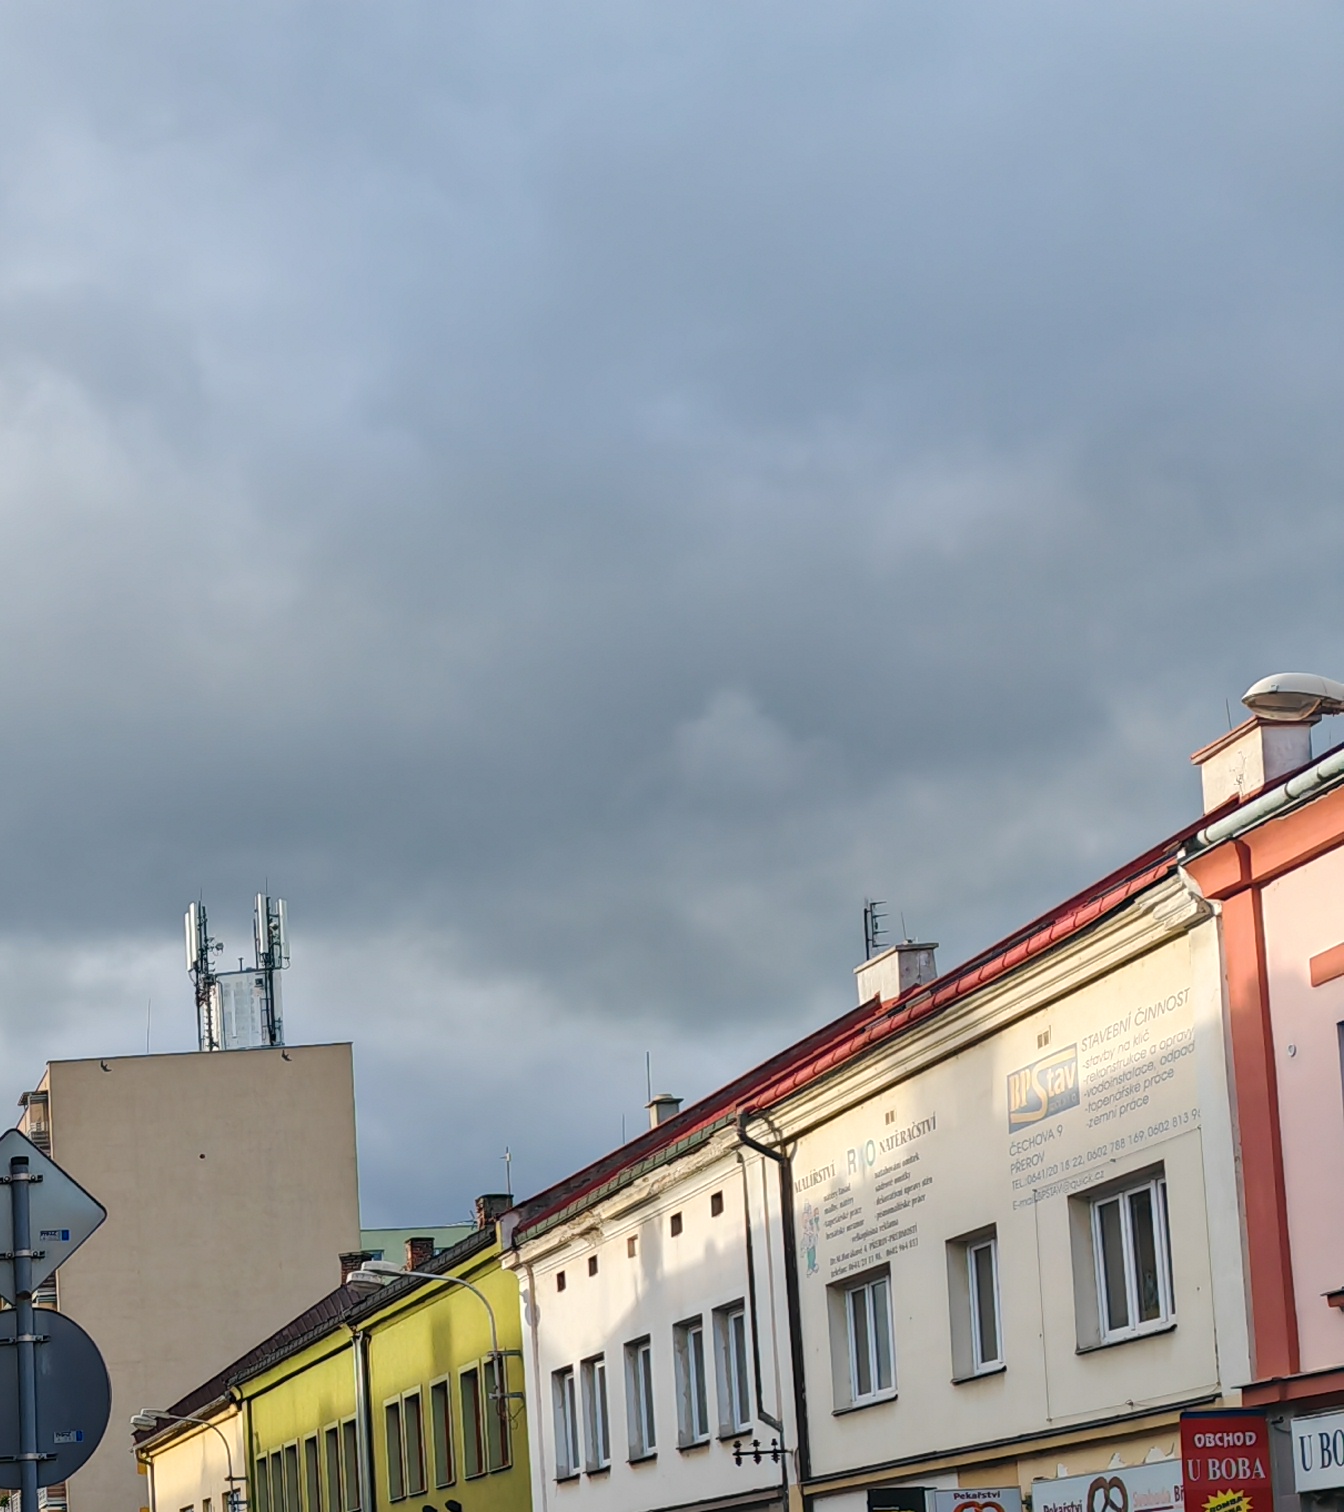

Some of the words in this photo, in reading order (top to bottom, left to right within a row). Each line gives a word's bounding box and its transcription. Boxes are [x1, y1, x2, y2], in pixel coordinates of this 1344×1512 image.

[1081, 1012, 1131, 1052] STAVEBNÍ
[1134, 987, 1190, 1027] ČINNOST
[1009, 1130, 1056, 1157] ČECHOVA
[1057, 1124, 1064, 1137] 9
[1010, 1151, 1045, 1175] PŘEROV
[1194, 1431, 1257, 1448] OBCHOD
[1298, 1435, 1313, 1472] U
[1187, 1458, 1201, 1482] U
[1208, 1457, 1266, 1481] BOBA
